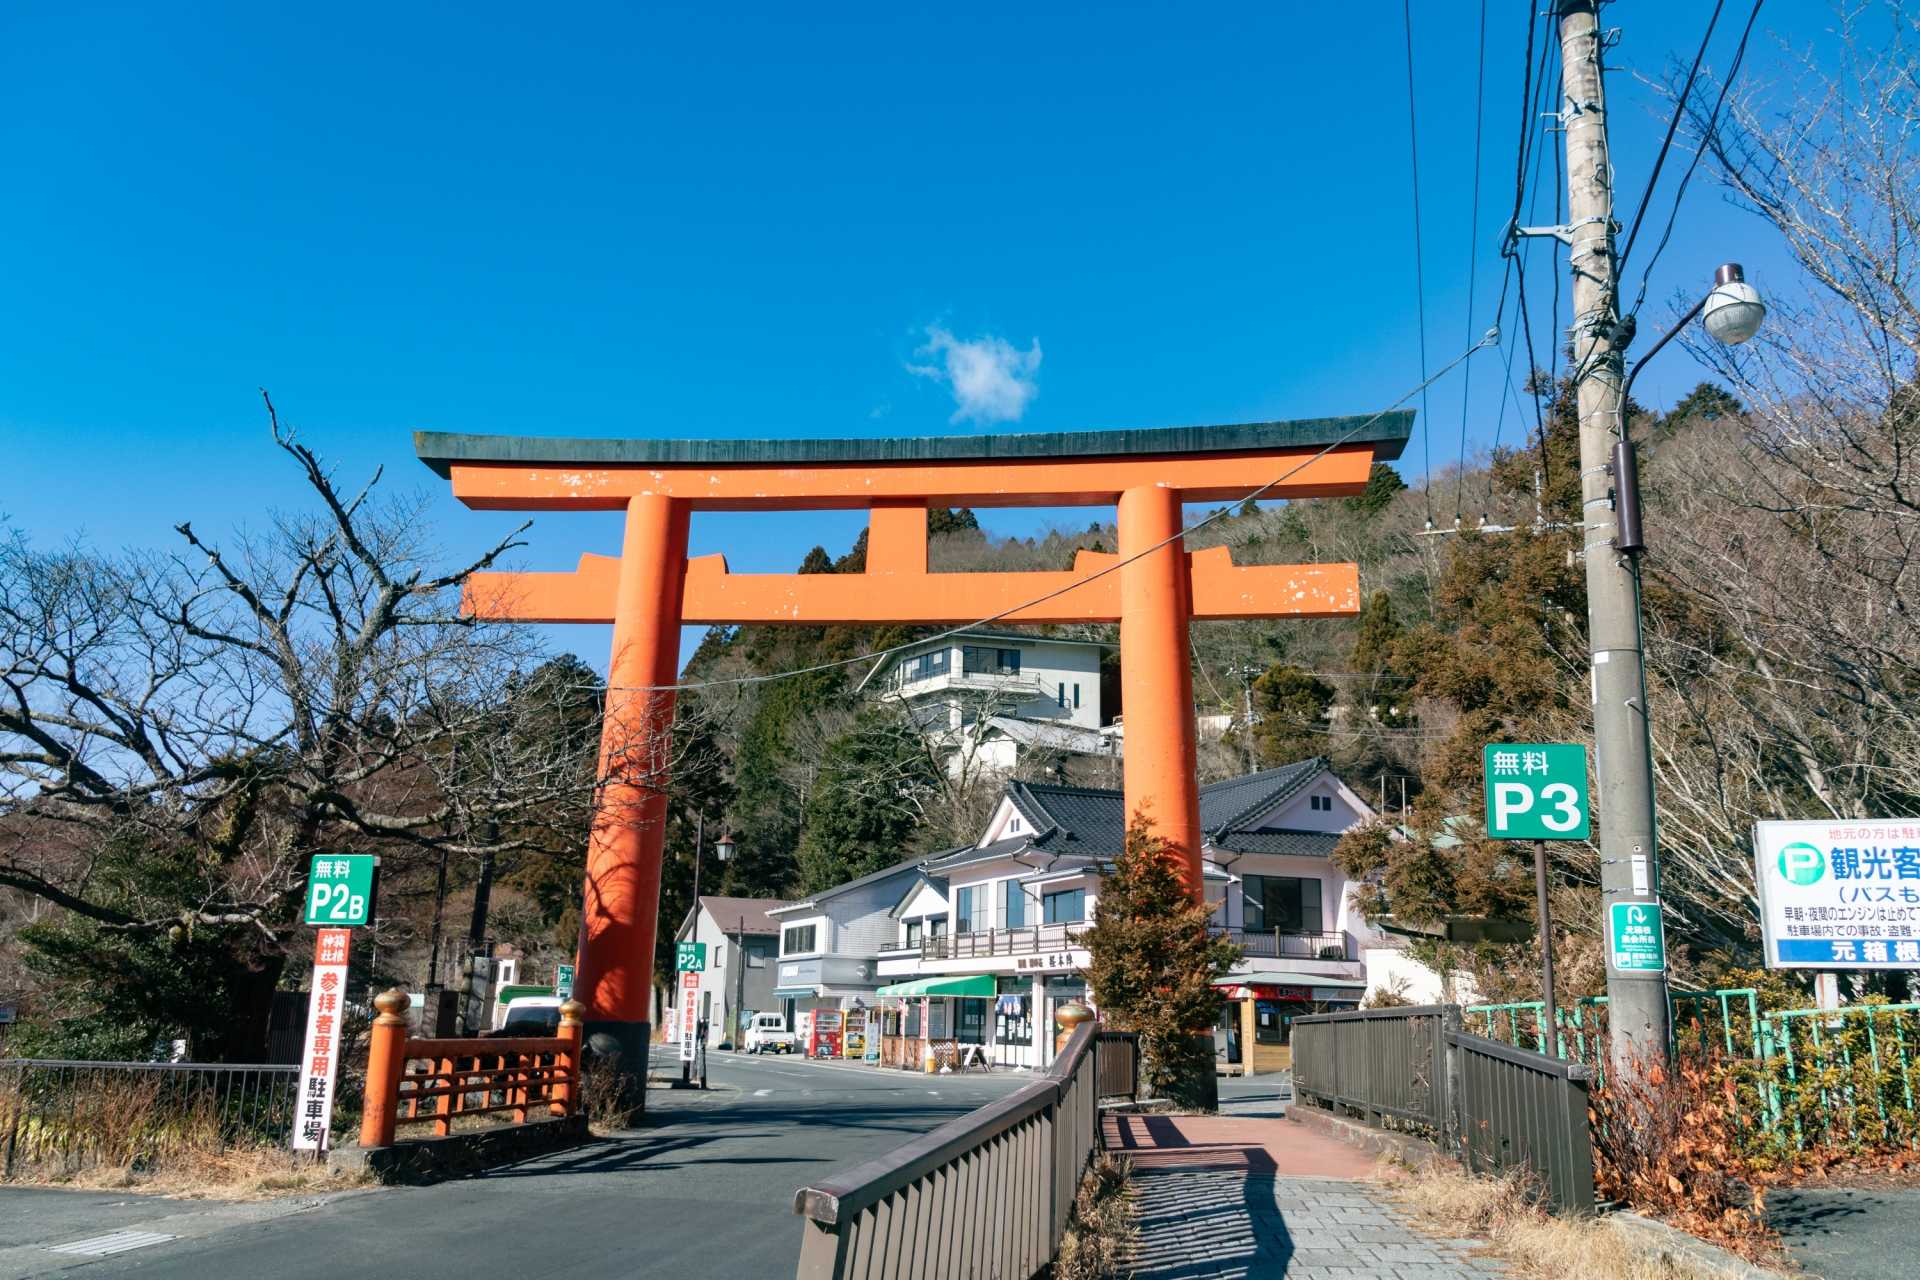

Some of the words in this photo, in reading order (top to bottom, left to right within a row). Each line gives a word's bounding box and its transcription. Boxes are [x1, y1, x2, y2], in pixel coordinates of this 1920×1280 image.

[1493, 751, 1549, 776] 無料
[1494, 782, 1582, 831] P3
[1829, 827, 1920, 840] 地元の方は駐
[315, 860, 350, 879] 無料
[1831, 847, 1920, 880] 観光客
[310, 883, 364, 919] P2B
[678, 954, 703, 969] P2A
[1831, 941, 1920, 962] 元箱根
[302, 972, 339, 1142] 参拝者専用駐車場
